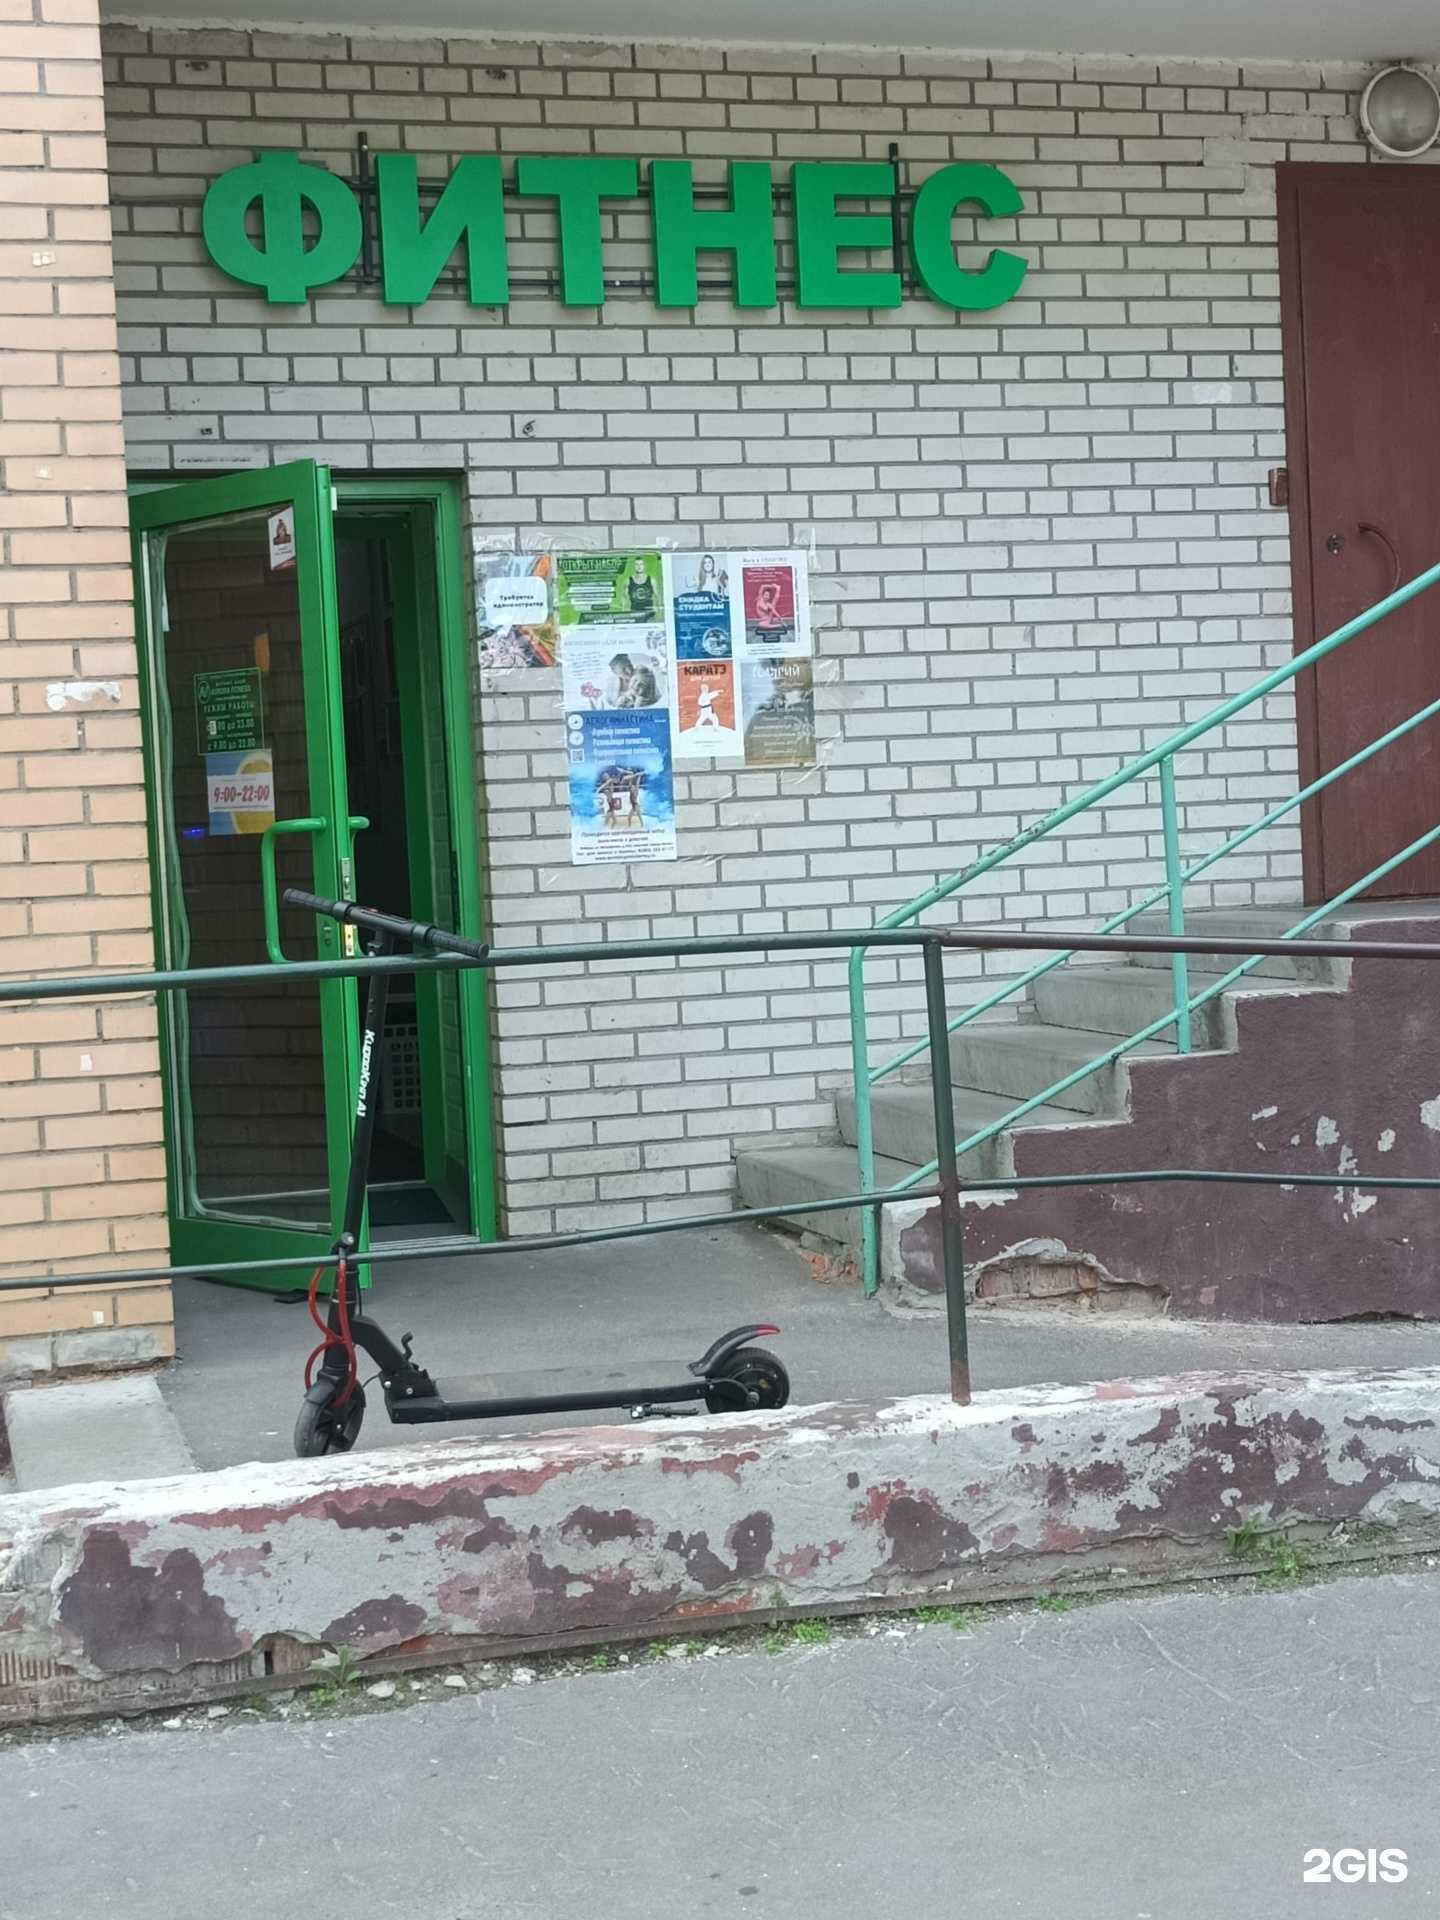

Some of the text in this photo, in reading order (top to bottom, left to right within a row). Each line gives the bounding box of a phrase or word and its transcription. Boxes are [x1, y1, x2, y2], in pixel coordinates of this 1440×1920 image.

[202, 151, 1028, 312] ФИТНЕС
[684, 664, 727, 676] КАРАТЭ
[213, 783, 271, 803] 9:00-22:00
